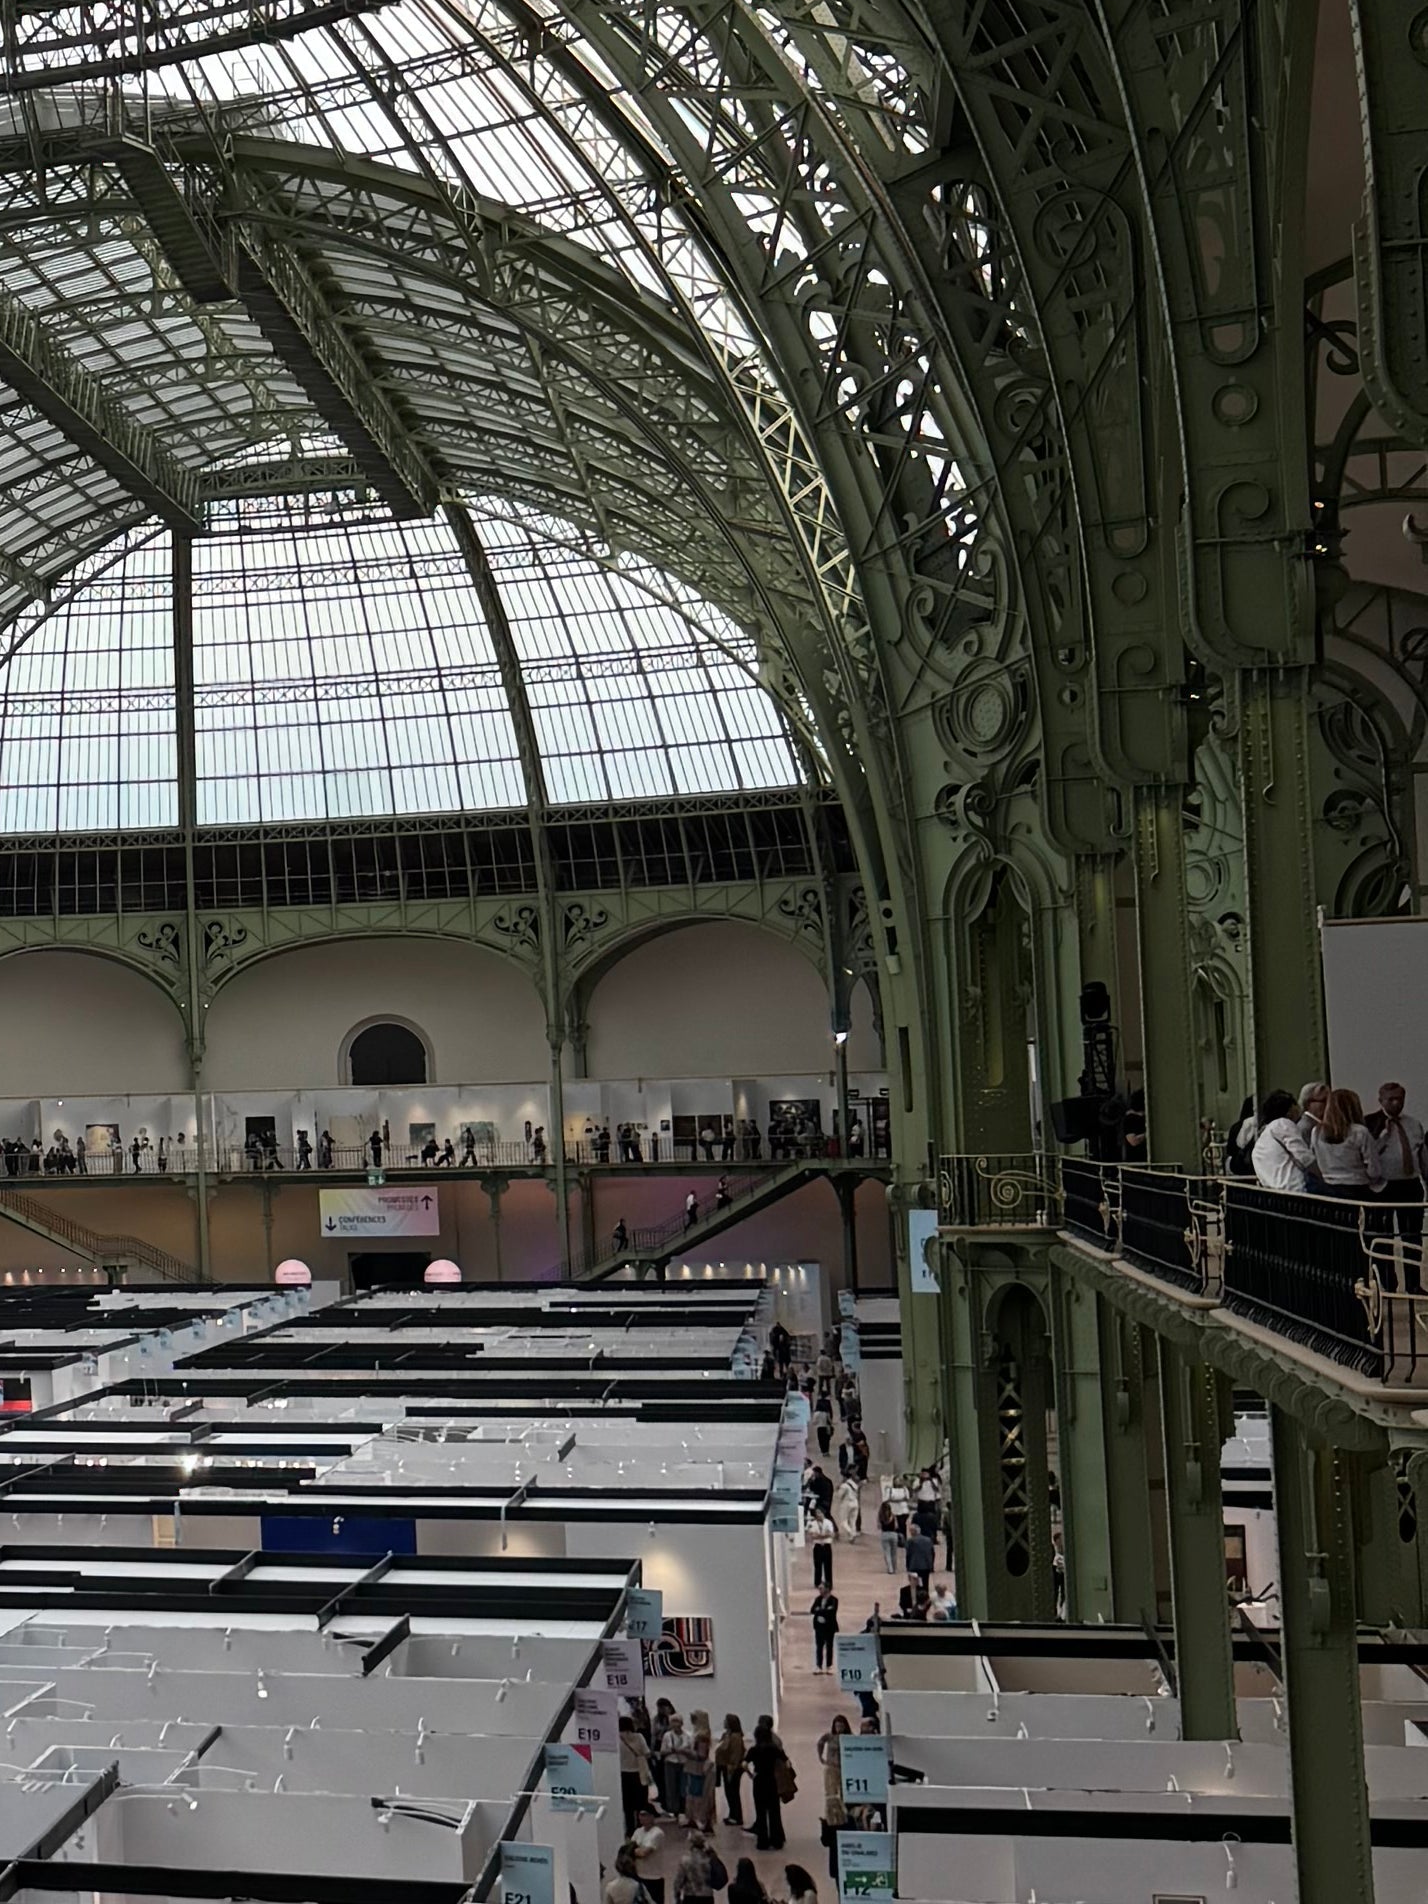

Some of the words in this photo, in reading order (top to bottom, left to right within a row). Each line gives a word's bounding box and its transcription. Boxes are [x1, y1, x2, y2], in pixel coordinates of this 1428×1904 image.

[606, 1674, 628, 1686] E18
[841, 1668, 862, 1681] F10
[578, 1727, 601, 1742] E19
[845, 1778, 868, 1792] F11
